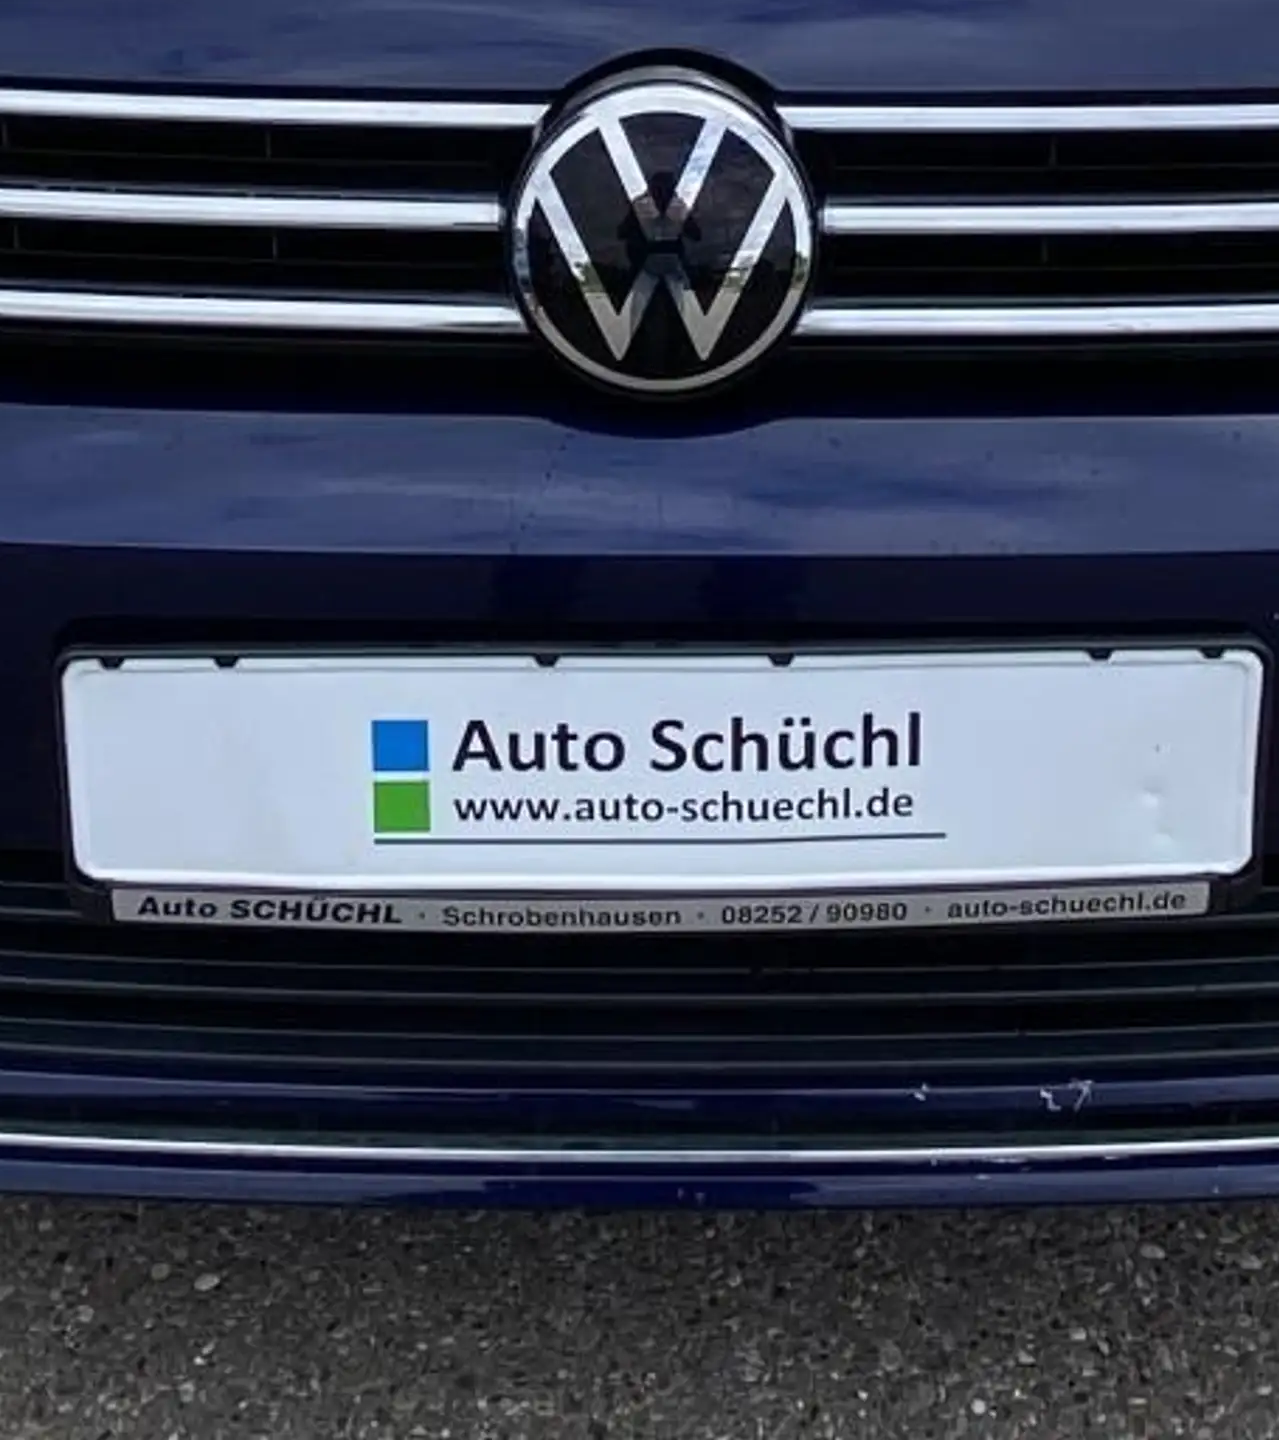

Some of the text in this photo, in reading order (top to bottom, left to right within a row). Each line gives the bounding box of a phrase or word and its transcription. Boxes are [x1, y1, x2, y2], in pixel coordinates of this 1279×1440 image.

[451, 711, 921, 773] Auto Schüchl
[453, 786, 914, 823] www.auto-schuechl.de
[137, 895, 219, 919] Auto
[229, 893, 403, 925] SCHÜCHL
[441, 905, 682, 928] Schrobenhausen
[947, 891, 1187, 919] auto-schuechl.de
